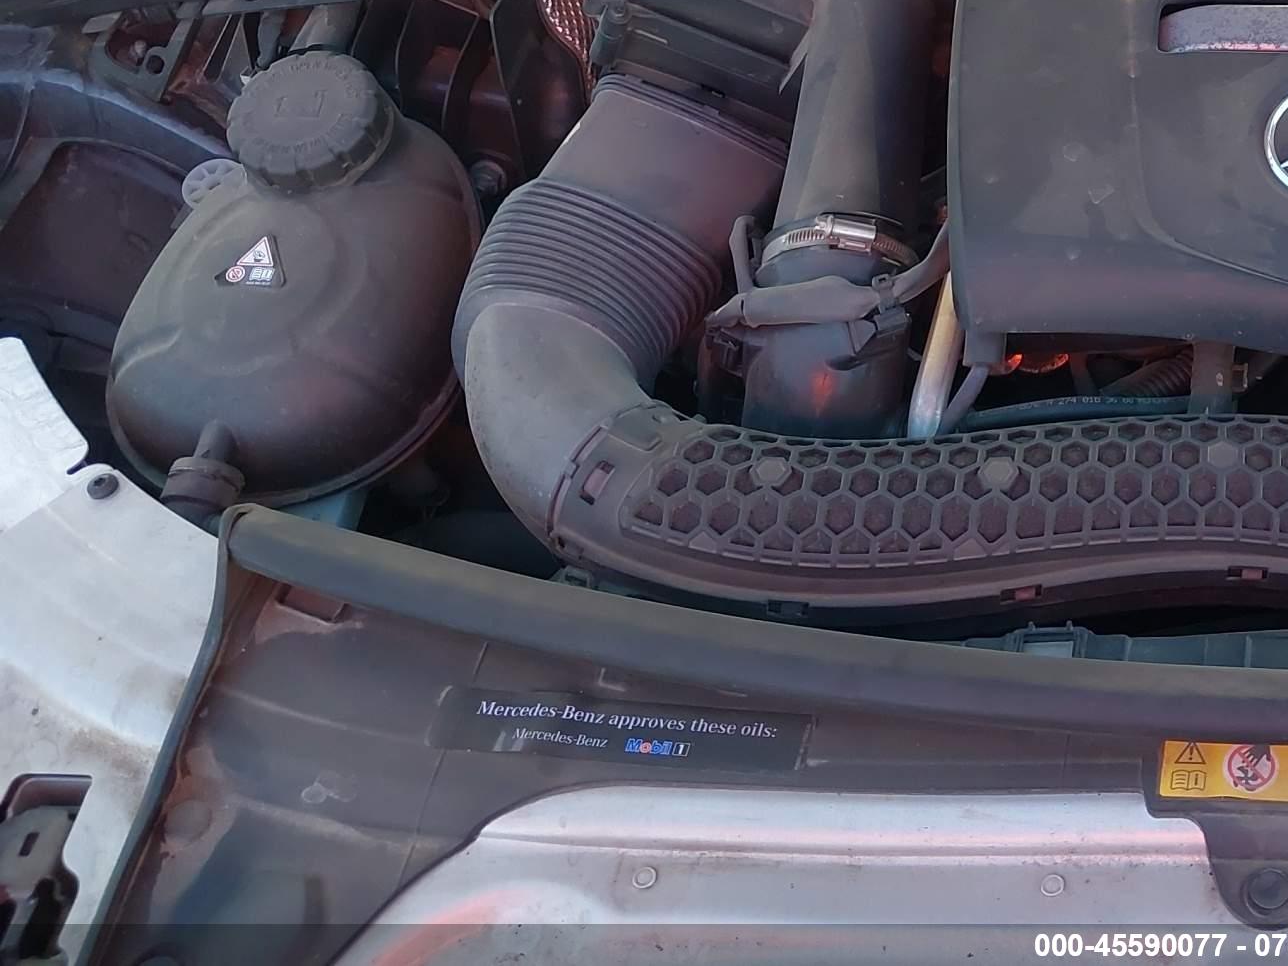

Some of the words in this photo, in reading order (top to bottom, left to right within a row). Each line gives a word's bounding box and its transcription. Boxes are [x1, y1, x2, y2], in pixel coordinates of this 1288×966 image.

[476, 700, 605, 725] Mercedes-Benz
[608, 715, 687, 734] approves
[690, 718, 737, 736] these
[740, 722, 778, 739] oils:
[512, 727, 609, 749] Mercedes-Benz
[624, 737, 672, 756] Mobil
